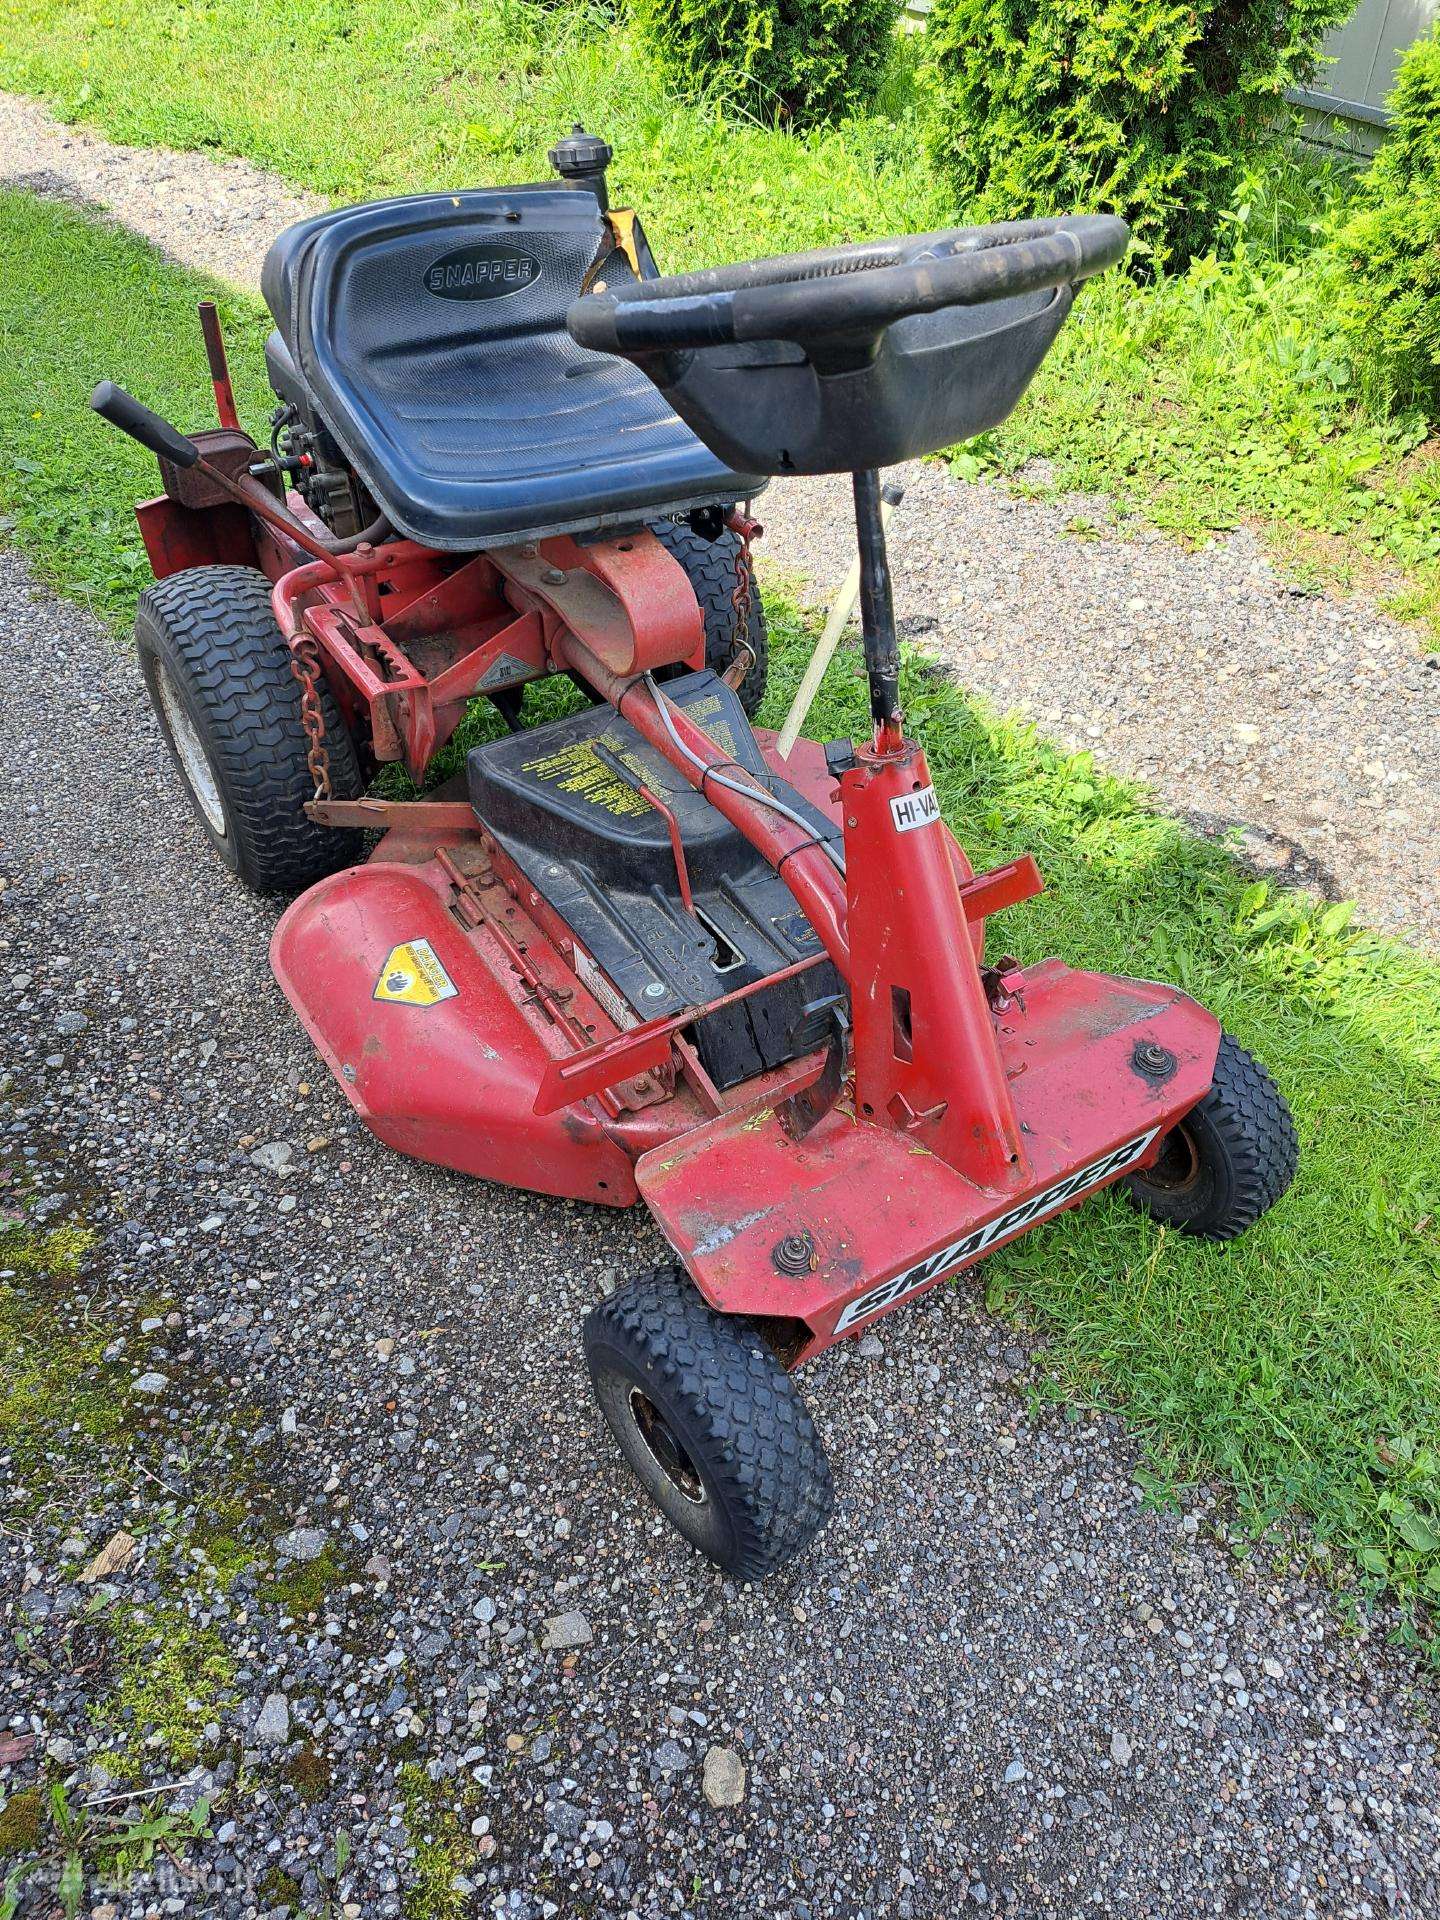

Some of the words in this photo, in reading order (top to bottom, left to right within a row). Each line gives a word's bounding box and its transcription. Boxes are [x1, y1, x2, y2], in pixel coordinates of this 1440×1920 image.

[430, 257, 533, 290] SNAPPER
[416, 947, 448, 989] DANGER
[847, 1135, 1148, 1323] SNAPPER
